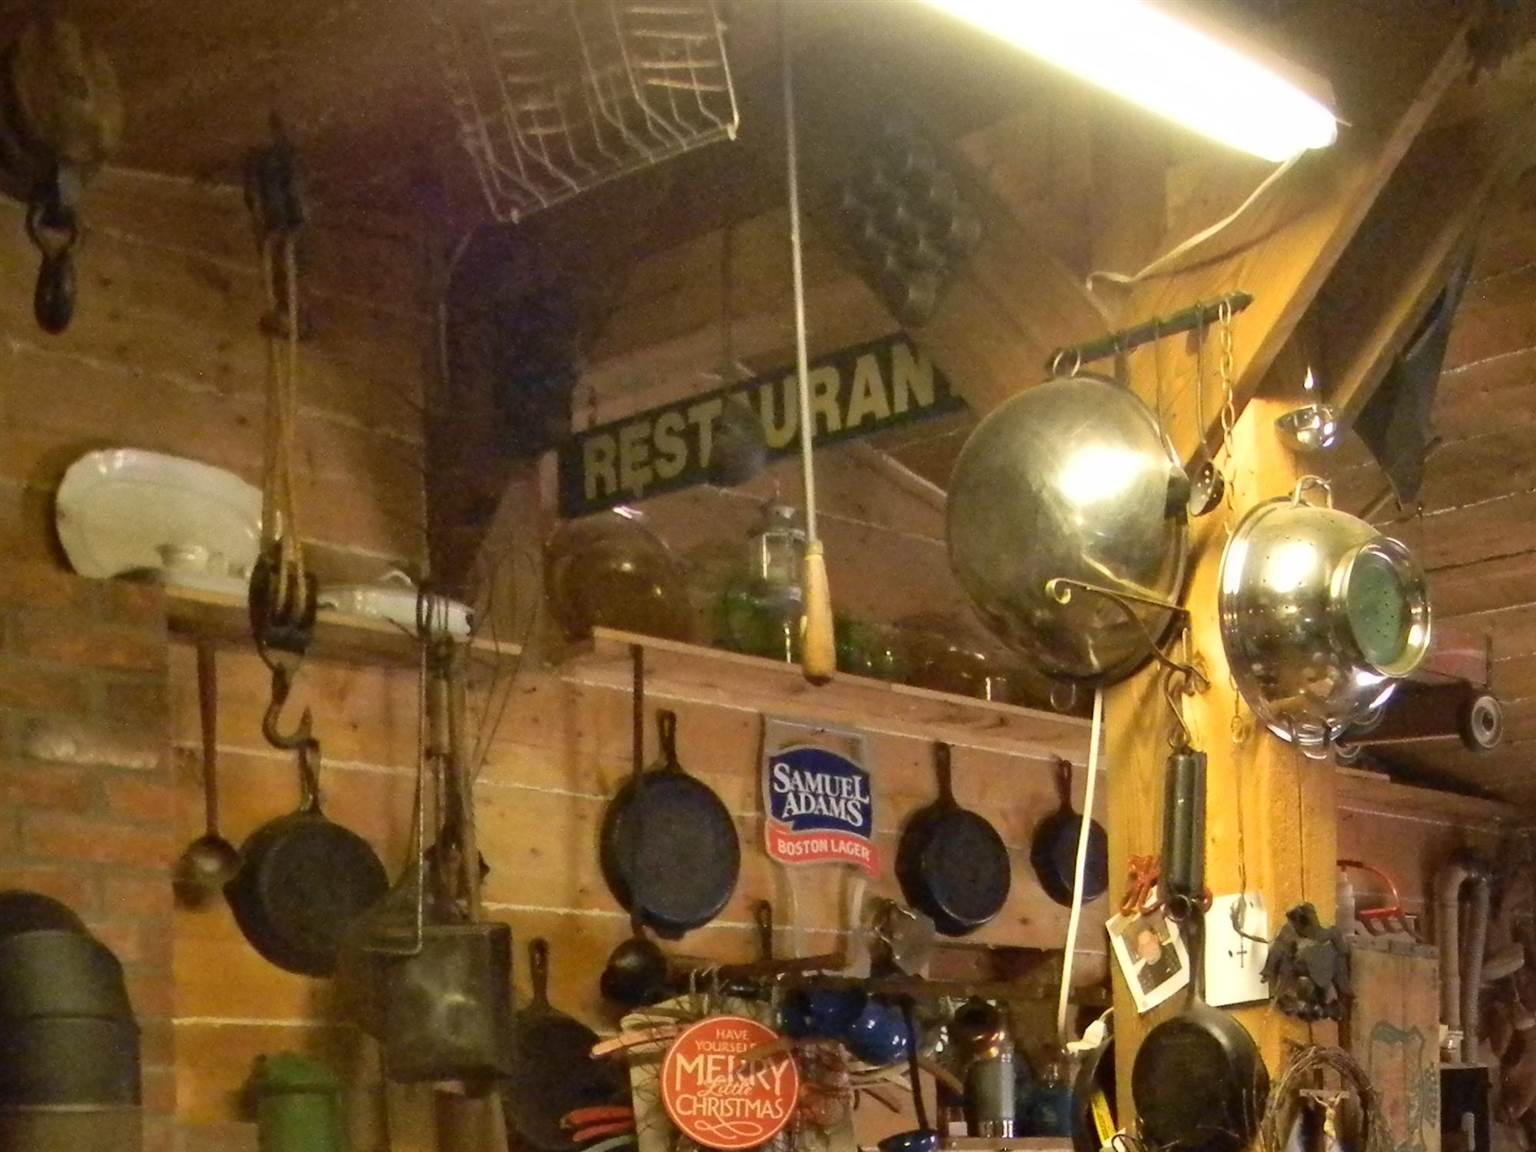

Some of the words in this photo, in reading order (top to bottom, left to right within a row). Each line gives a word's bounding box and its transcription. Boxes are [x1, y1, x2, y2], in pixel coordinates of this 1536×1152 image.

[583, 343, 940, 500] RESTURAN
[773, 763, 870, 804] SAMUEL
[782, 792, 863, 827] ADAMS
[777, 838, 829, 856] BOSTON
[831, 839, 870, 862] LAGER
[715, 1028, 750, 1041] HAVE
[675, 1094, 784, 1119] CHRISTMAS
